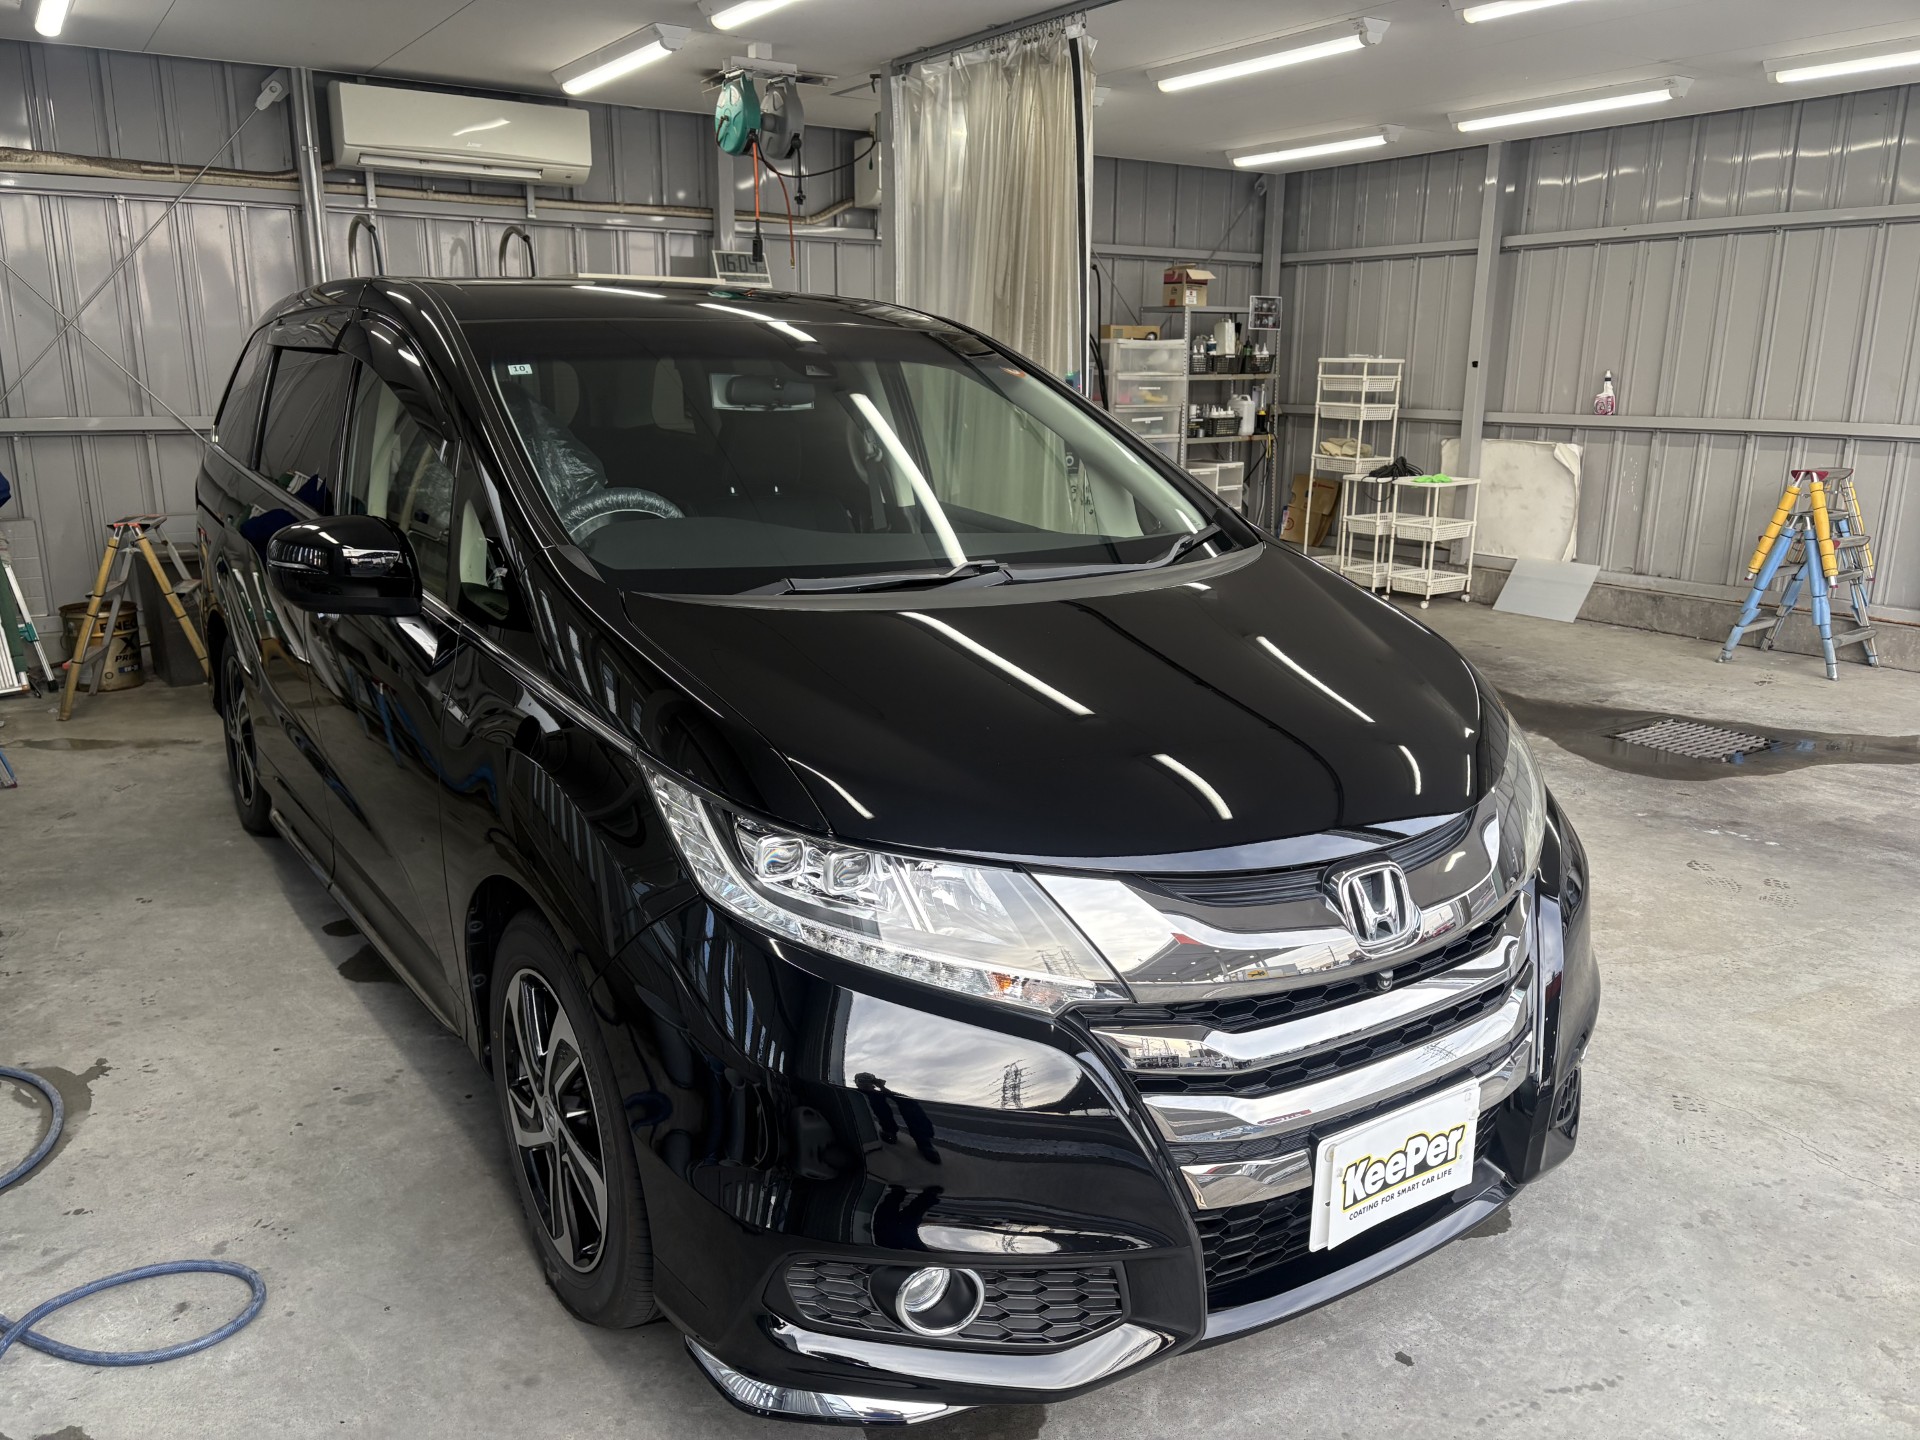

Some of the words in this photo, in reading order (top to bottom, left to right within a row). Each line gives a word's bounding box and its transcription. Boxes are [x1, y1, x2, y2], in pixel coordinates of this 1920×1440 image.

[1342, 1125, 1466, 1211] KeePer
[1348, 1201, 1379, 1221] COATING
[1380, 1192, 1395, 1205] FOR
[1397, 1181, 1420, 1197] SMART
[1421, 1175, 1435, 1187] CAR
[1437, 1168, 1452, 1180] LIFE
